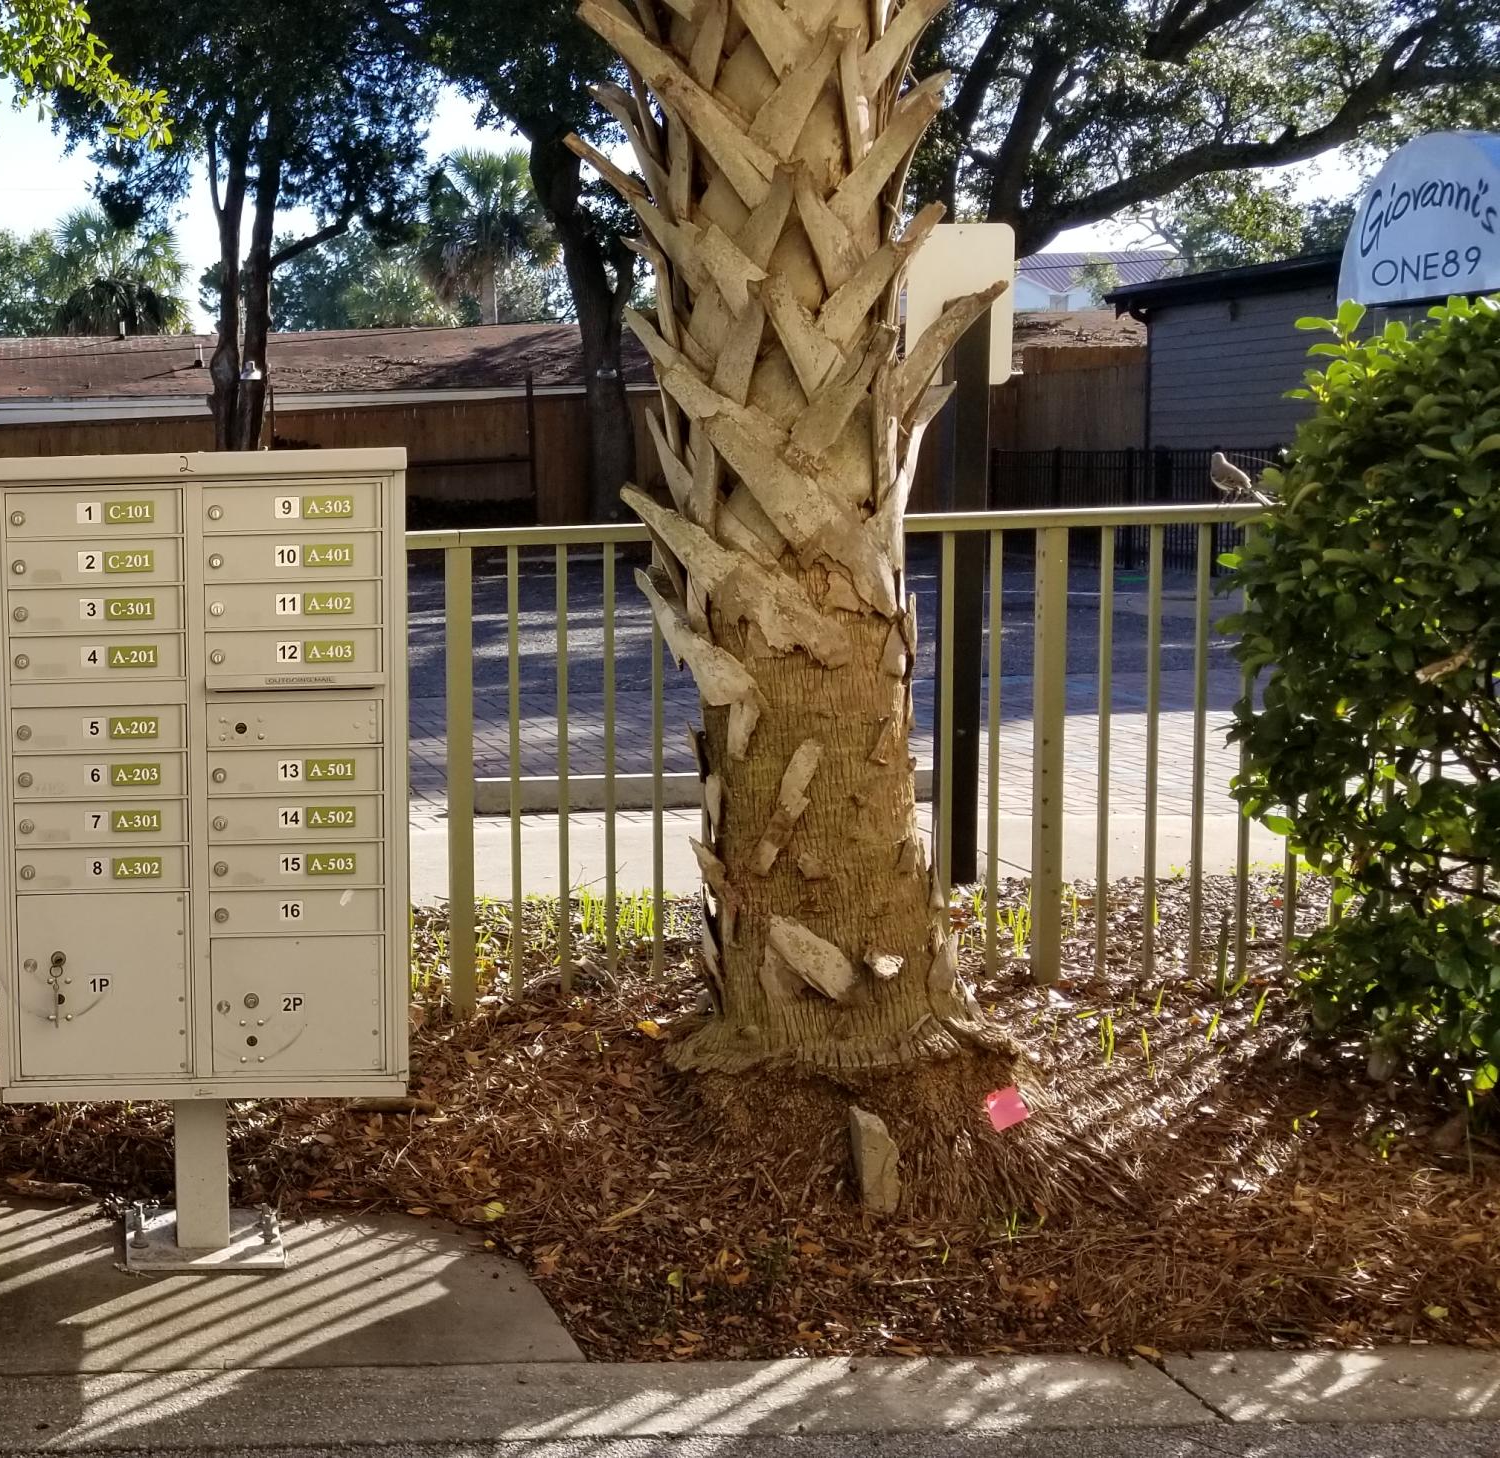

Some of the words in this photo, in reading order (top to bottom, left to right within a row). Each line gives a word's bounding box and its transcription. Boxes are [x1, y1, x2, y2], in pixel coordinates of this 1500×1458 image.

[1360, 178, 1498, 258] Giovanni's
[1371, 246, 1482, 287] ONE89
[179, 455, 195, 473] 2
[84, 505, 92, 521] 1
[109, 505, 151, 519] C-101
[281, 500, 292, 515] 9
[307, 499, 351, 514] A-303
[85, 554, 96, 570] 2
[108, 554, 150, 569] C-201
[277, 549, 297, 564] 10
[307, 548, 350, 562] A-401
[86, 602, 97, 617] 3
[110, 602, 152, 616] C-301
[278, 596, 296, 612] 11
[307, 597, 352, 611] A-402
[87, 649, 99, 665] 4
[112, 650, 156, 664] A-201
[278, 644, 298, 660] 12
[308, 645, 352, 659] A-403
[89, 721, 100, 736] 5
[113, 721, 157, 735] A-202
[90, 768, 101, 783] 6
[115, 767, 158, 782] A-203
[280, 763, 299, 778] 13
[310, 763, 353, 777] A-501
[91, 814, 101, 829] 7
[116, 814, 159, 828] A-301
[281, 810, 300, 825] 14
[310, 810, 354, 824] A-502
[92, 860, 103, 876] 8
[117, 862, 160, 875] A-302
[281, 857, 301, 872] 15
[310, 857, 354, 871] A-503
[281, 903, 301, 918] 16
[89, 978, 110, 993] 1P
[282, 997, 303, 1012] 2P
